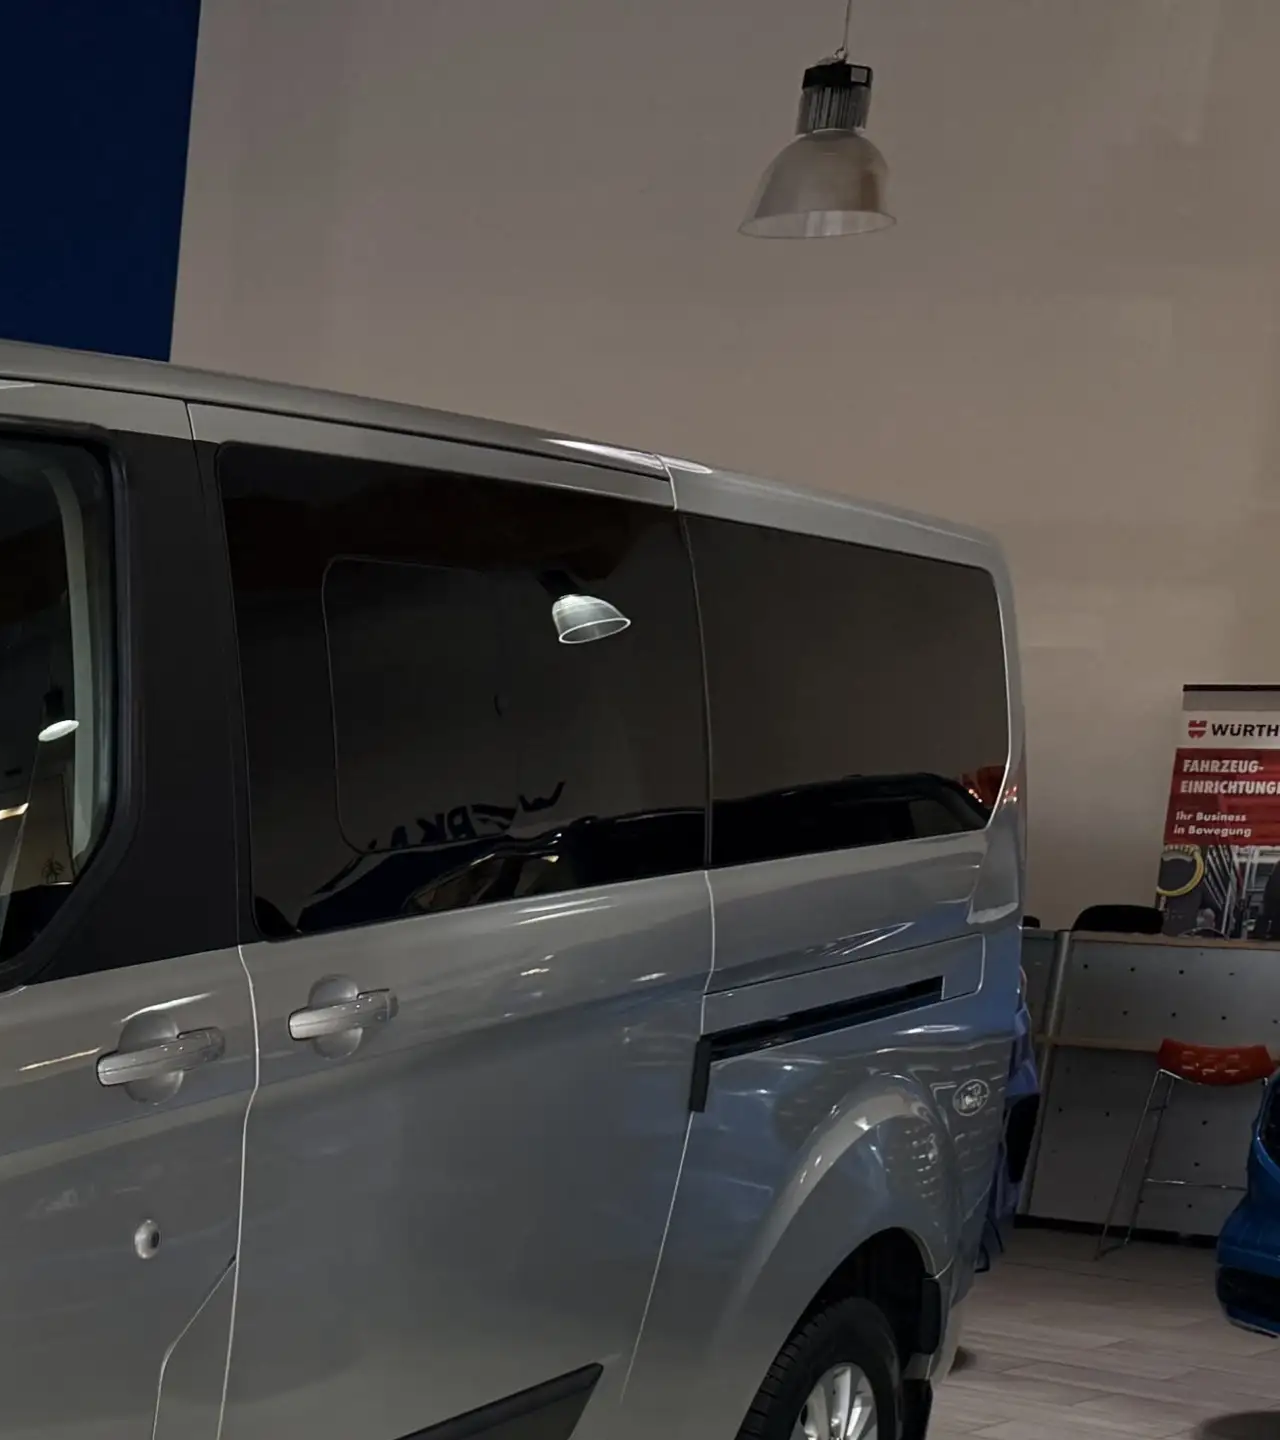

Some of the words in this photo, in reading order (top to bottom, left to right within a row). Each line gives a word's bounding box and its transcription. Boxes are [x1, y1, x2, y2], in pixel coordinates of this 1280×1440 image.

[1211, 723, 1280, 737] WÜRTH
[1183, 760, 1264, 773] FAHRZEUG-
[1175, 811, 1193, 820] Ihr
[1195, 812, 1247, 822] Business
[1173, 825, 1185, 834] in
[1187, 825, 1252, 837] Bewegung
